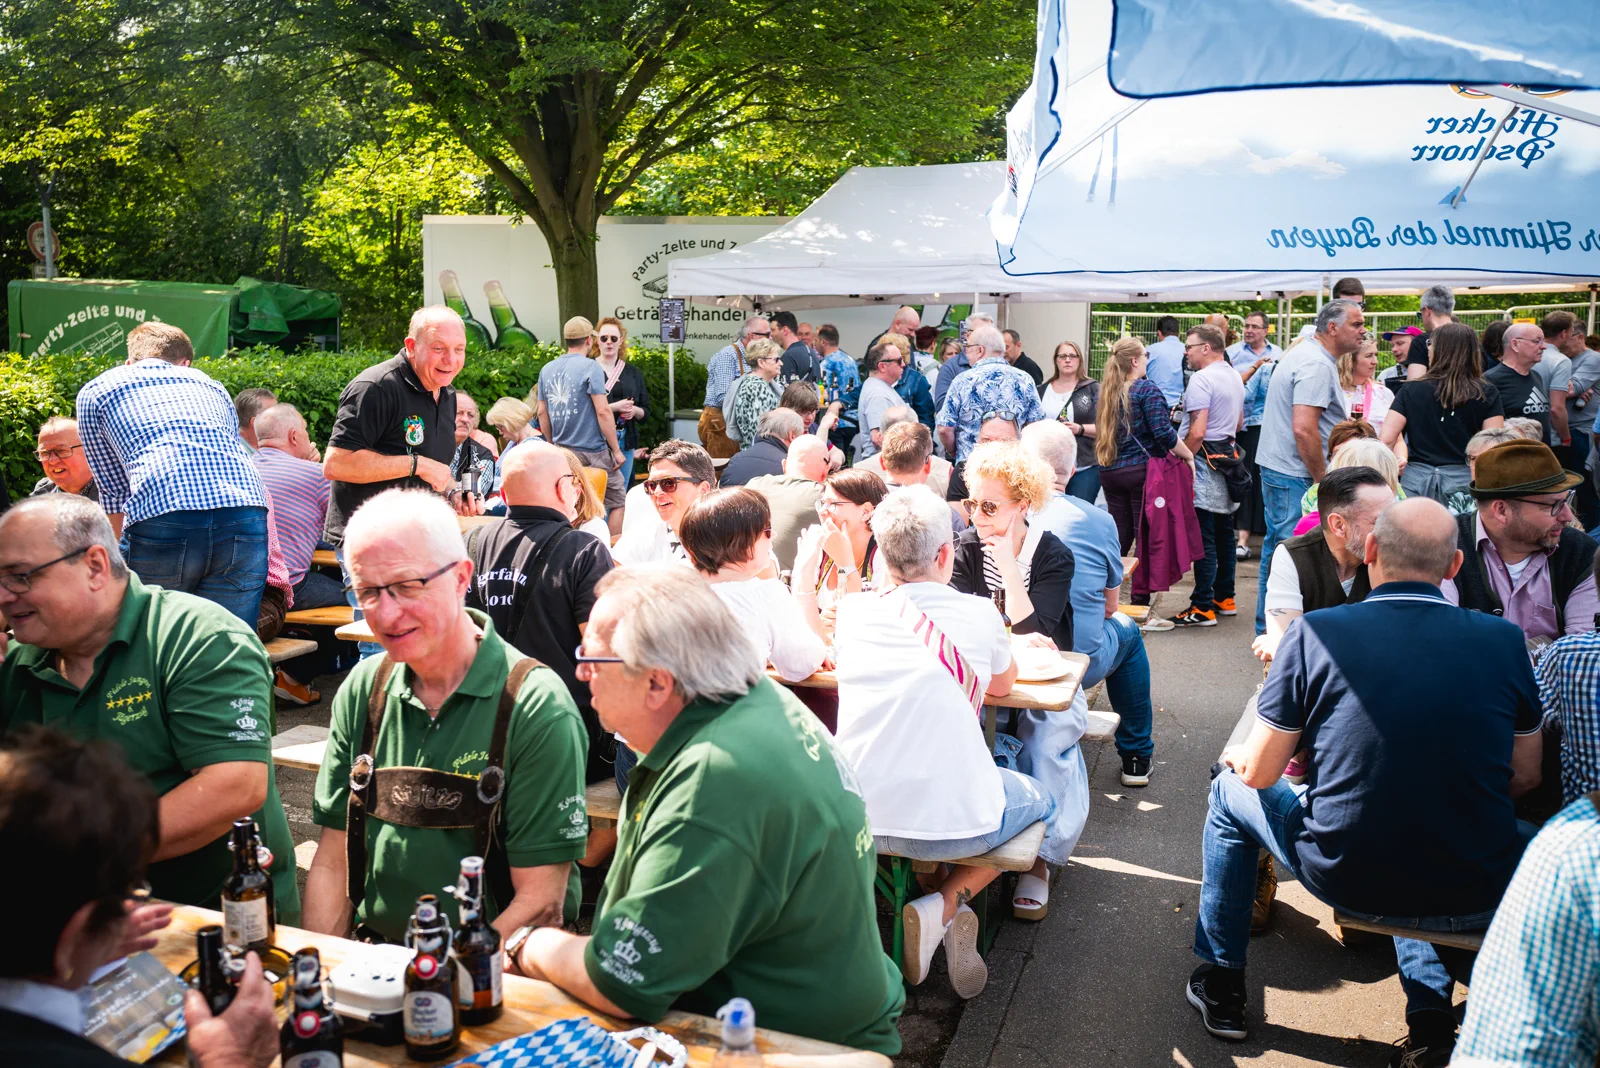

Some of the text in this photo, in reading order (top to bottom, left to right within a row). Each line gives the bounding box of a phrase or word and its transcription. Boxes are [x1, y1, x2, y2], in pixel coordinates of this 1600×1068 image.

[632, 239, 726, 281] Party-Zelte und
[115, 305, 146, 323] und
[614, 305, 747, 321] Geträehandel
[1523, 402, 1550, 415] adida
